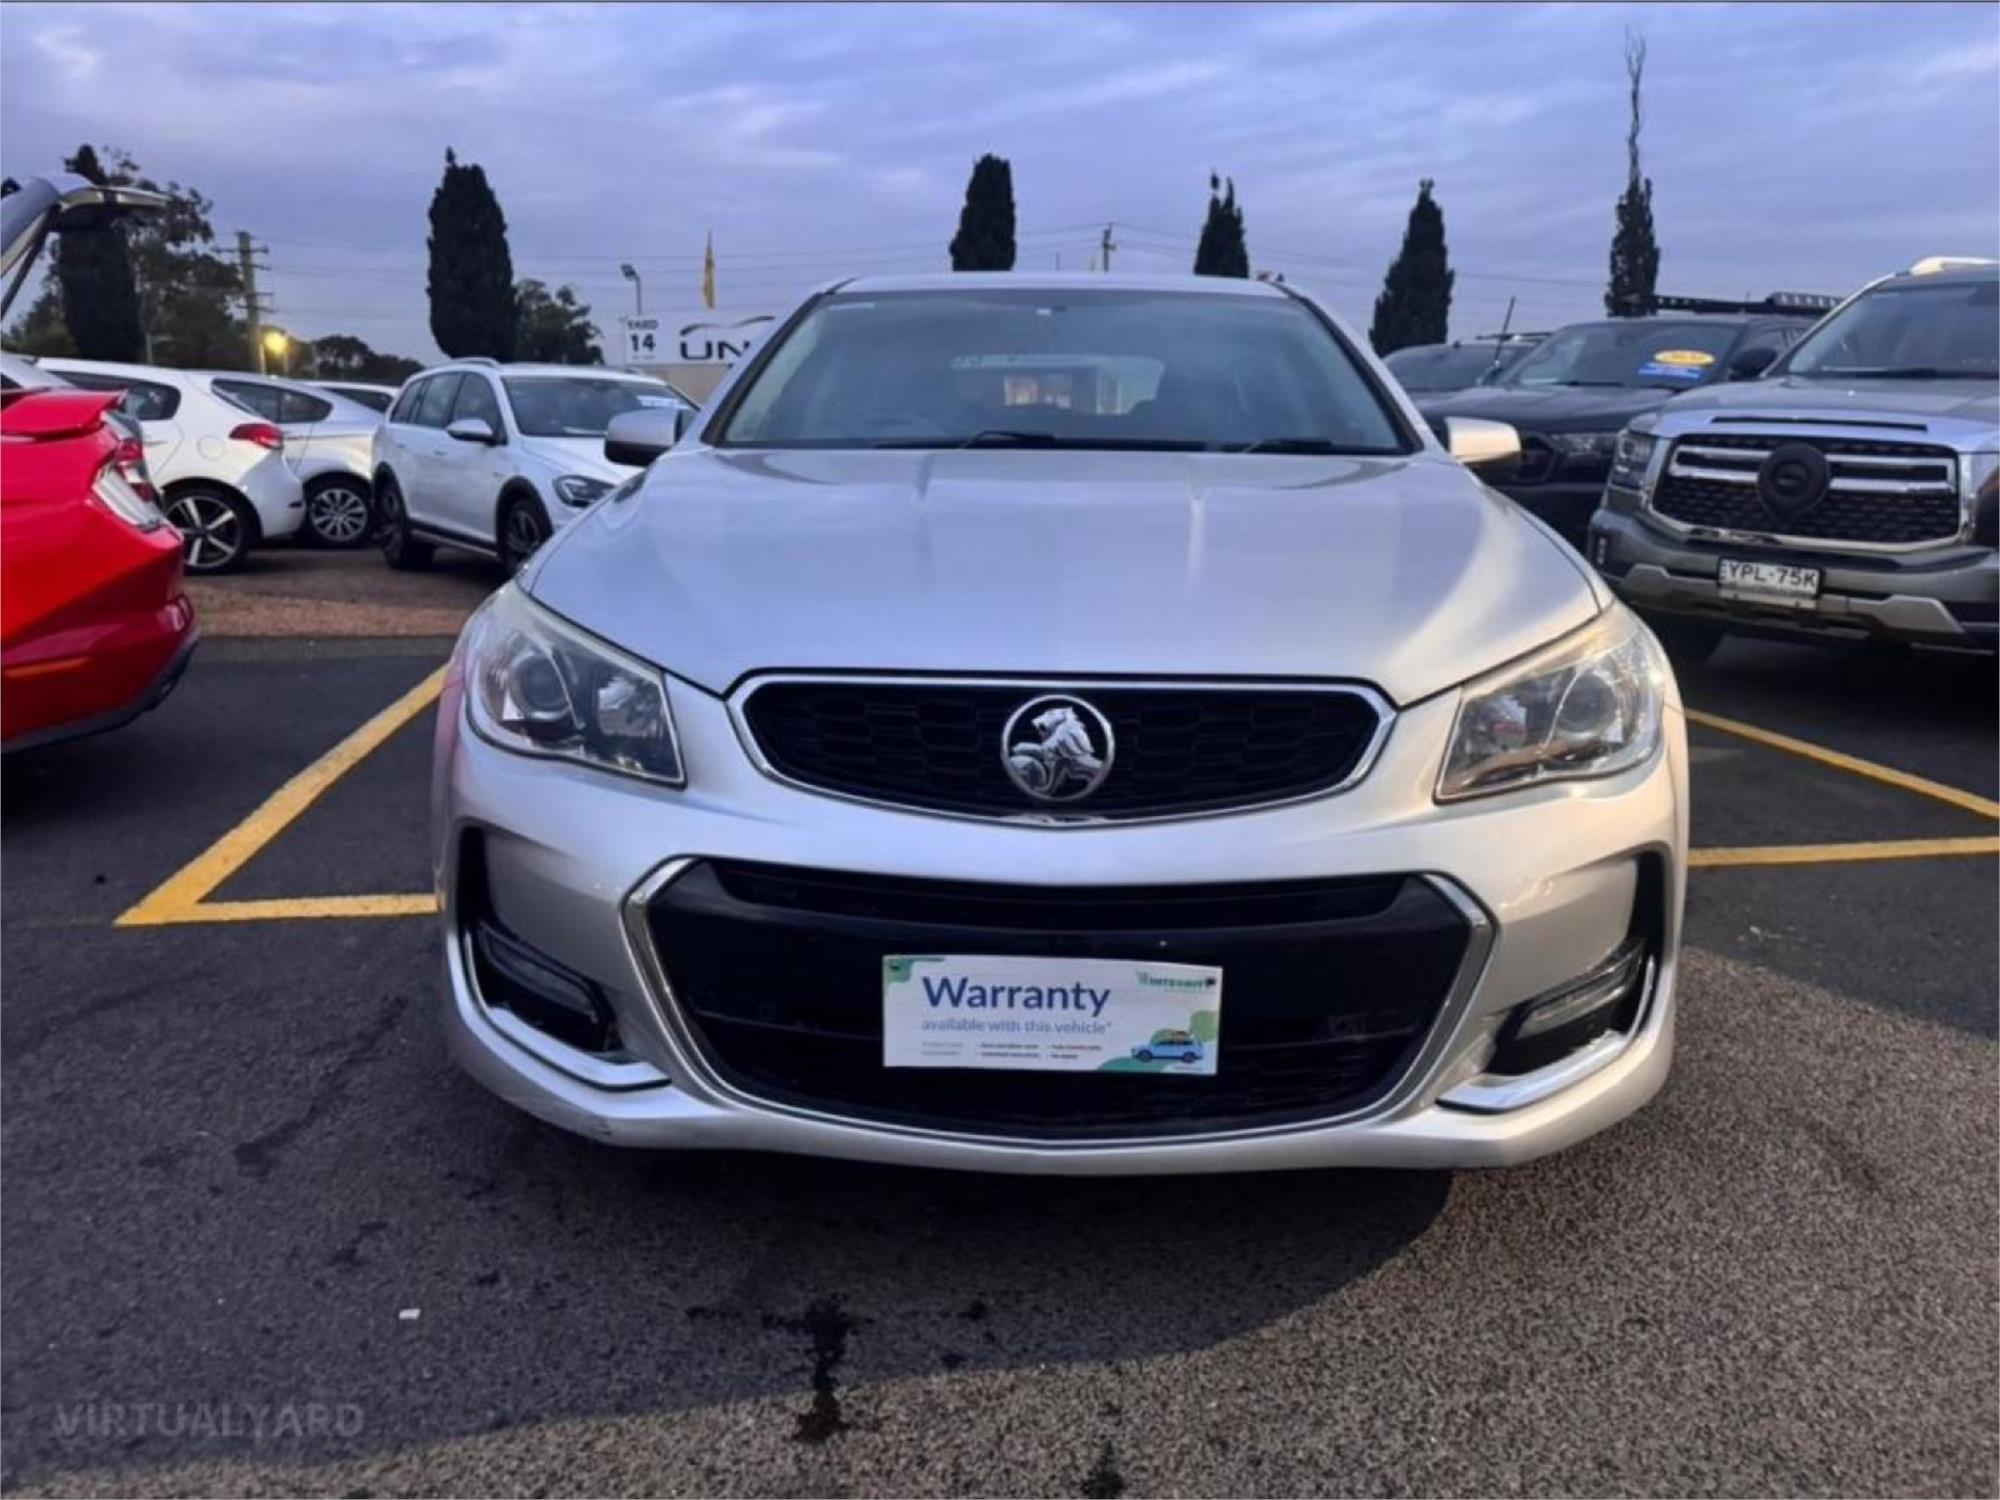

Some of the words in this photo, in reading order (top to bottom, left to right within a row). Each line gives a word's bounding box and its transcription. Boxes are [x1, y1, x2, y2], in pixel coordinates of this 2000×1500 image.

[627, 320, 658, 330] YARD
[631, 333, 656, 352] 14
[922, 976, 1111, 1017] Warranty
[921, 1018, 985, 1032] available
[988, 1019, 1020, 1032] with
[1024, 1019, 1051, 1033] this
